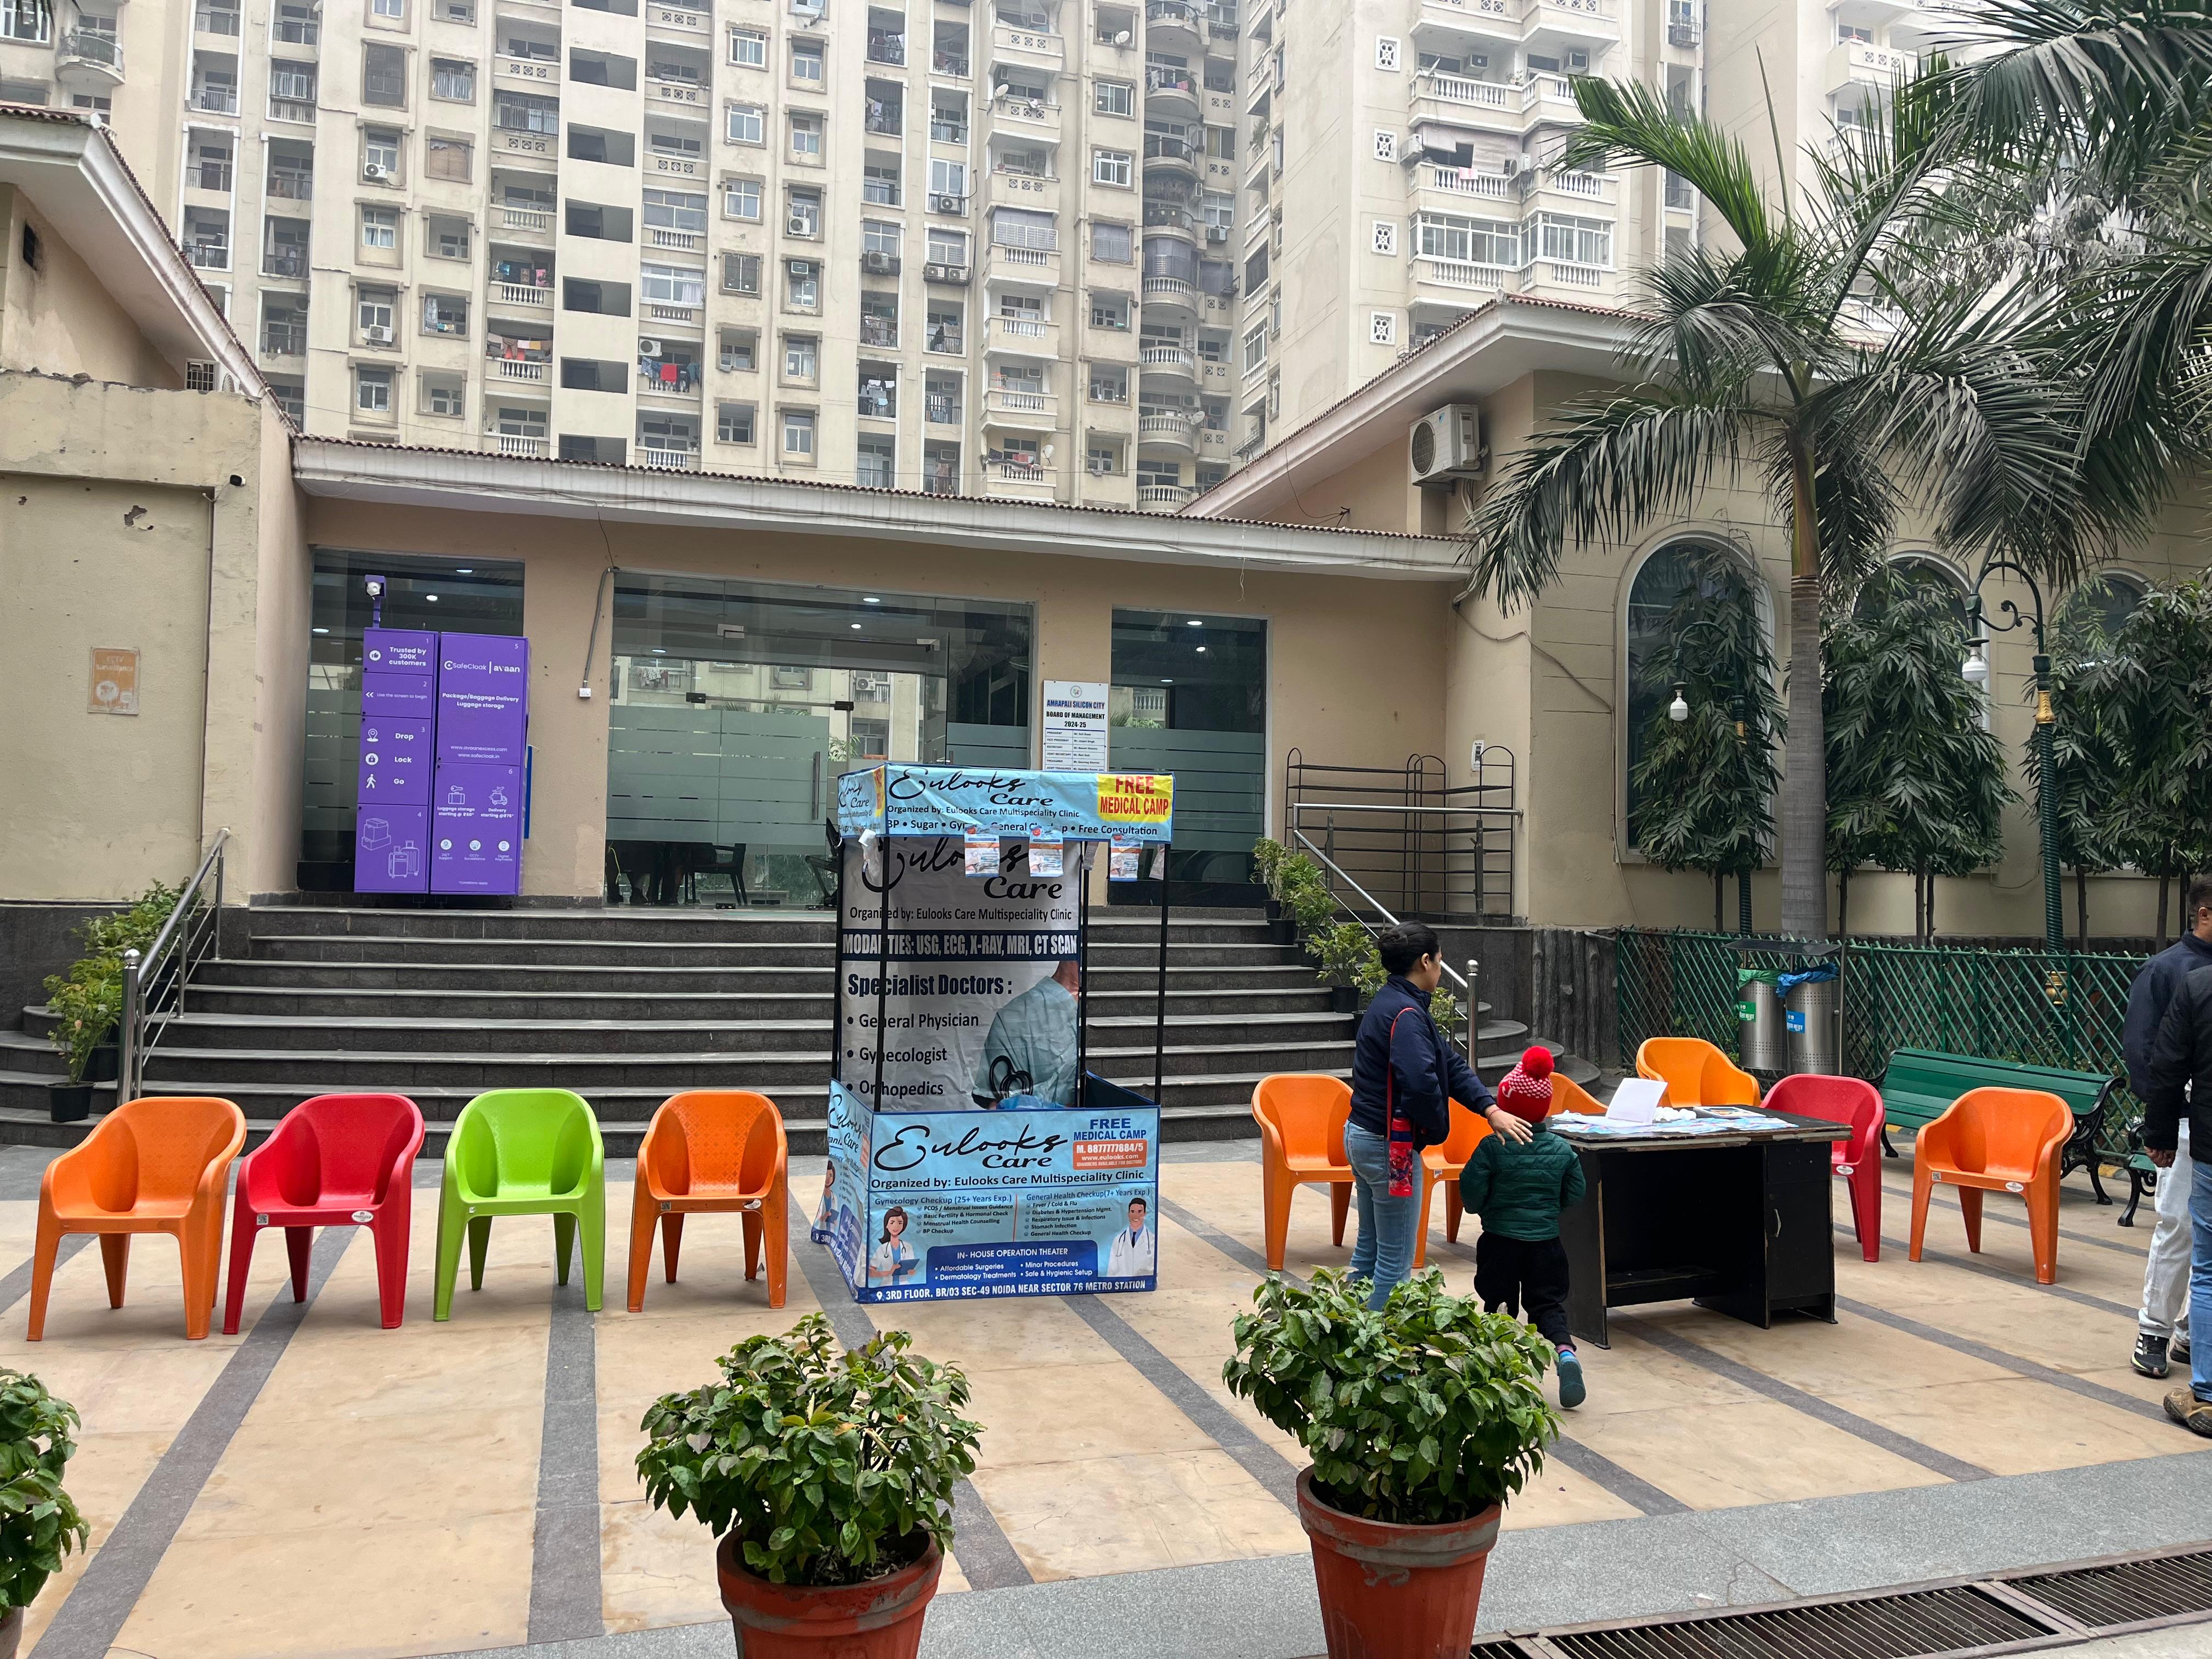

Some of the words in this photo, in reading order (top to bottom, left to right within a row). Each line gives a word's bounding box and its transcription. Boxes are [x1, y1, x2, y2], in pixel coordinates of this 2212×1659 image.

[453, 662, 487, 670] SafeCloak
[442, 692, 495, 702] Package/Baggage
[1047, 699, 1072, 708] AMRAPALI
[1073, 701, 1092, 709] SILICON
[395, 733, 414, 741] Drop
[889, 768, 1025, 799] Eulooks
[1115, 775, 1155, 794] FREE
[851, 797, 870, 808] Care
[990, 793, 1053, 806] Care
[1100, 797, 1141, 815] MEDICAL
[1143, 798, 1169, 815] CAMP
[888, 805, 929, 814] Organized
[932, 805, 944, 815] by:
[946, 806, 977, 815] Eulooks
[1000, 808, 1056, 818] Multispeciality
[1059, 810, 1079, 818] Clinic
[911, 821, 939, 831] Sugar
[1079, 825, 1098, 833] Free
[984, 876, 1063, 899] Care
[850, 907, 898, 921] Organied
[901, 907, 913, 922] by:
[917, 907, 952, 919] Eulooks
[955, 909, 975, 919] Care
[979, 909, 1048, 922] Multispeciality
[1051, 909, 1071, 920] Clinic
[916, 935, 941, 956] USG,
[944, 935, 968, 956] ECG,
[970, 935, 1004, 956] X-RAY,
[1007, 935, 1032, 956] MRI,
[1034, 934, 1048, 955] CT
[1051, 934, 1077, 955] SCAN
[859, 1014, 914, 1028] Geeral
[919, 1013, 979, 1030] Physician
[860, 1047, 947, 1065] Gyecologist
[859, 1080, 944, 1099] Orhopedics
[1090, 1118, 1131, 1130] FREE
[844, 1132, 859, 1153] Care
[1074, 1130, 1116, 1141] MEDICAL
[1119, 1130, 1147, 1139] CAMP
[874, 1124, 1068, 1171] Eulooks
[1076, 1145, 1086, 1154] M.
[982, 1154, 1052, 1169] Care
[871, 1178, 930, 1189] Organized
[934, 1178, 951, 1189] by:
[955, 1176, 998, 1186] Eulooks
[1002, 1176, 1027, 1184] Care
[1031, 1172, 1113, 1184] Multispeciality
[1115, 1170, 1144, 1180] Clinic
[1134, 1188, 1150, 1197] Exp.)
[875, 1197, 918, 1206] Gynecology
[921, 1197, 952, 1205] Checkup
[955, 1196, 970, 1204] (25+
[994, 1194, 1012, 1203] Exp.)
[970, 1250, 995, 1259] HOUSE
[996, 1249, 1037, 1257] OPERATION
[1039, 1248, 1068, 1256] THEATER
[886, 1291, 902, 1300] 3RD
[935, 1287, 960, 1297] BR/03
[962, 1286, 990, 1296] SEC-49
[992, 1284, 1015, 1294] NOIDA
[1018, 1283, 1039, 1293] NEAR
[1042, 1283, 1071, 1293] SECTOR
[1074, 1283, 1083, 1291] 76
[1085, 1281, 1113, 1290] METRO
[1115, 1280, 1146, 1290] STATION
